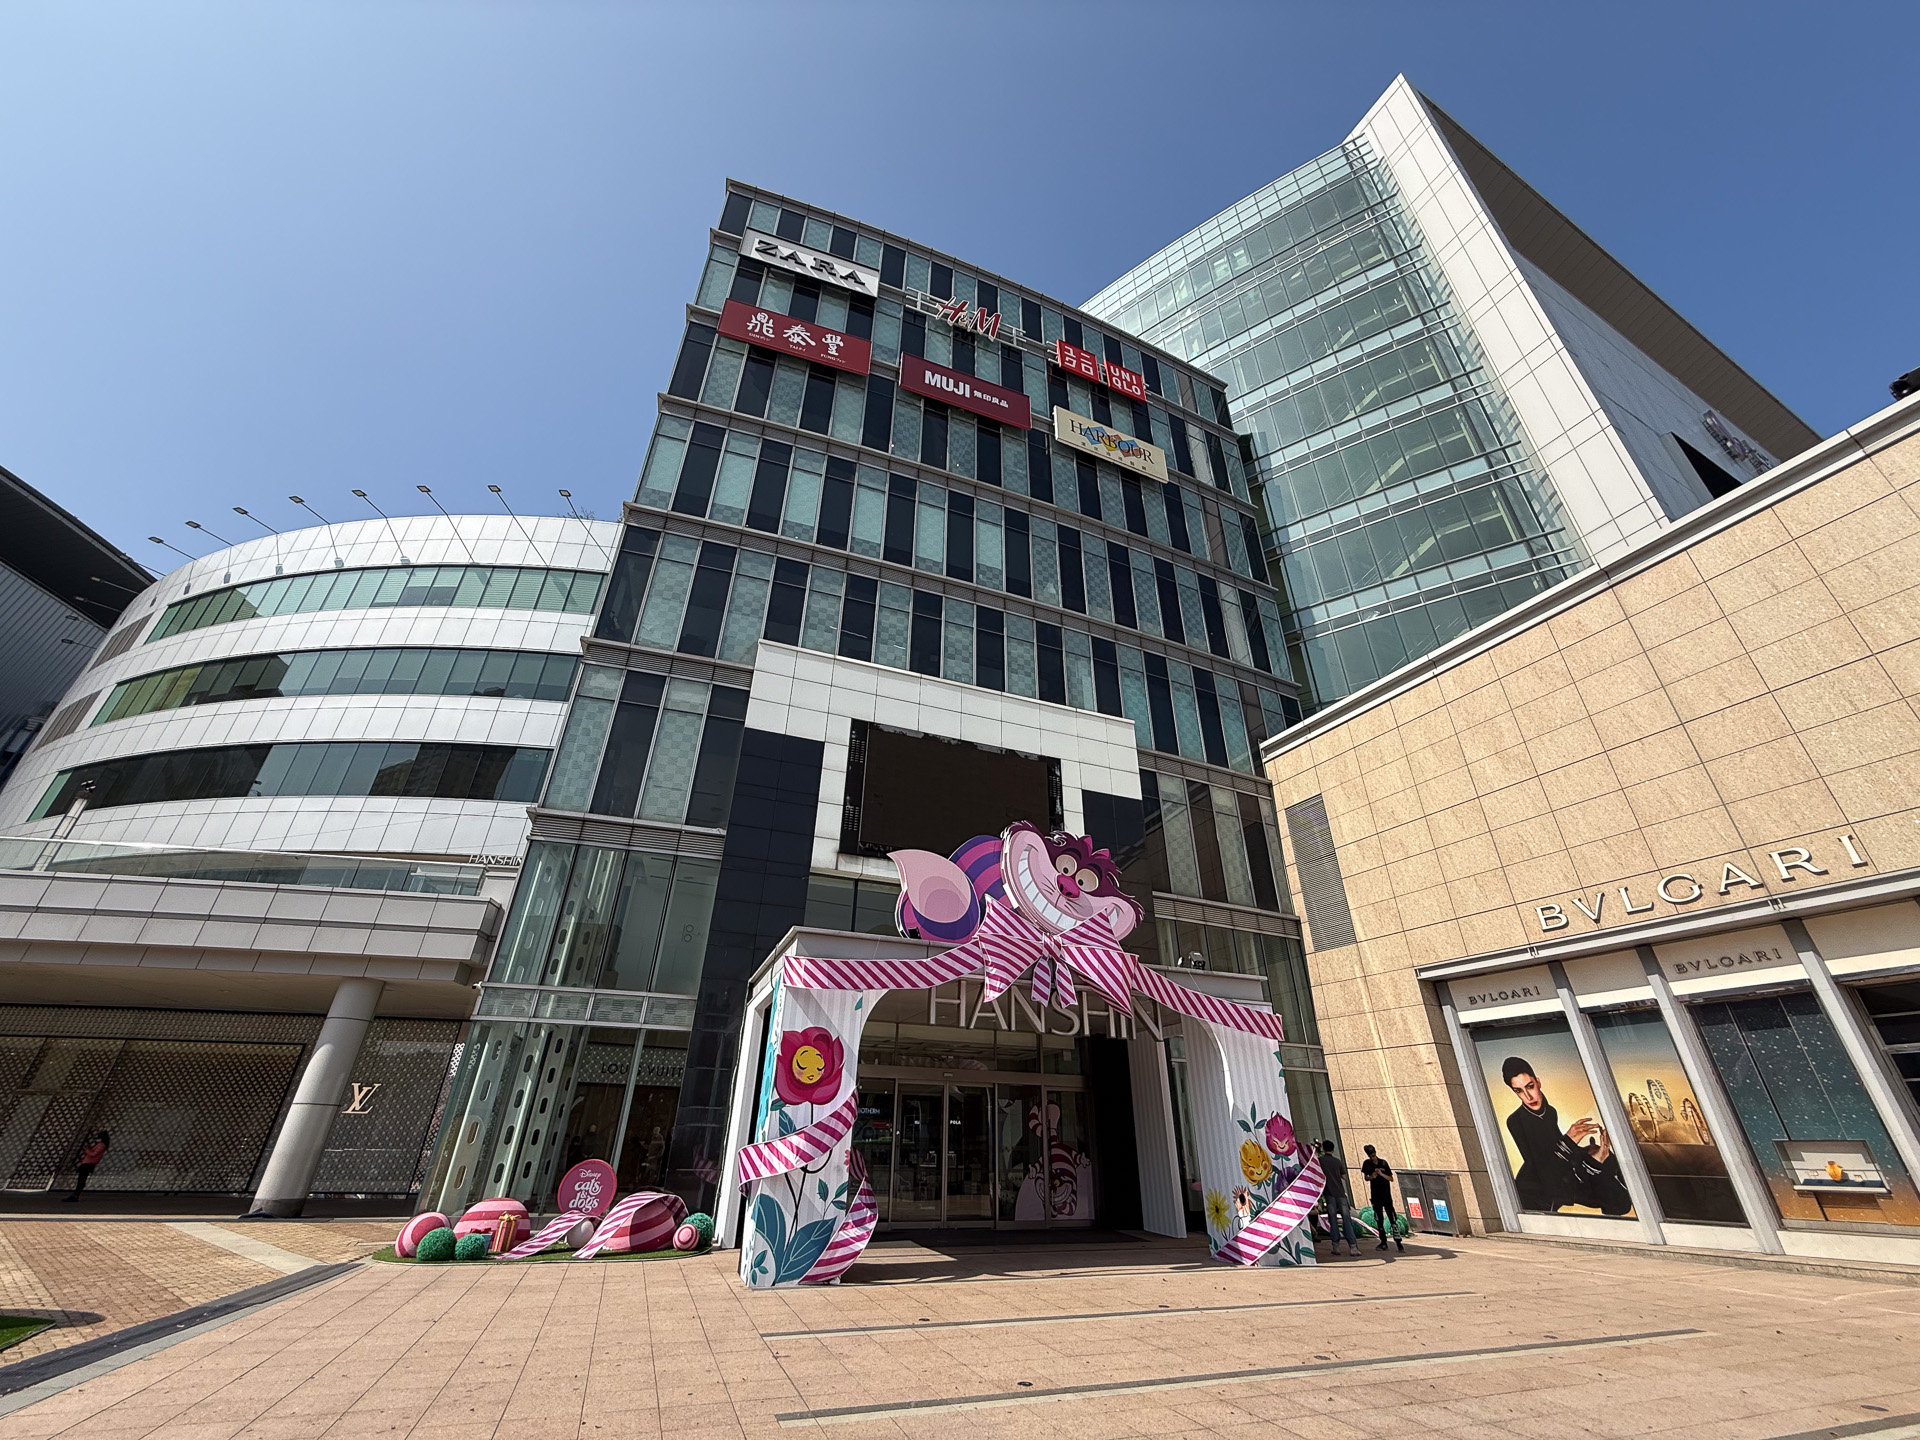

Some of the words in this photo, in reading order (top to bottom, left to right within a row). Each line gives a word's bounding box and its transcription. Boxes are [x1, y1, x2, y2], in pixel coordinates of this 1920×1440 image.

[755, 240, 866, 286] ZARA
[936, 296, 1003, 342] H&M
[746, 312, 845, 356] 鼎泰豐
[924, 369, 970, 398] MUJI
[1110, 365, 1137, 384] UNI
[1112, 376, 1141, 396] QLO
[1069, 419, 1154, 464] HARBOUR
[469, 854, 522, 866] HANSHIN
[1534, 834, 1868, 932] BVLGARI
[1672, 947, 1782, 974] BVLGARI
[1468, 985, 1541, 1006] BVLGARI
[929, 980, 1163, 1041] HANSHIN
[601, 1063, 642, 1076] LOUS
[574, 1178, 603, 1196] cats
[580, 1190, 588, 1199] &
[568, 1192, 599, 1213] dogs
